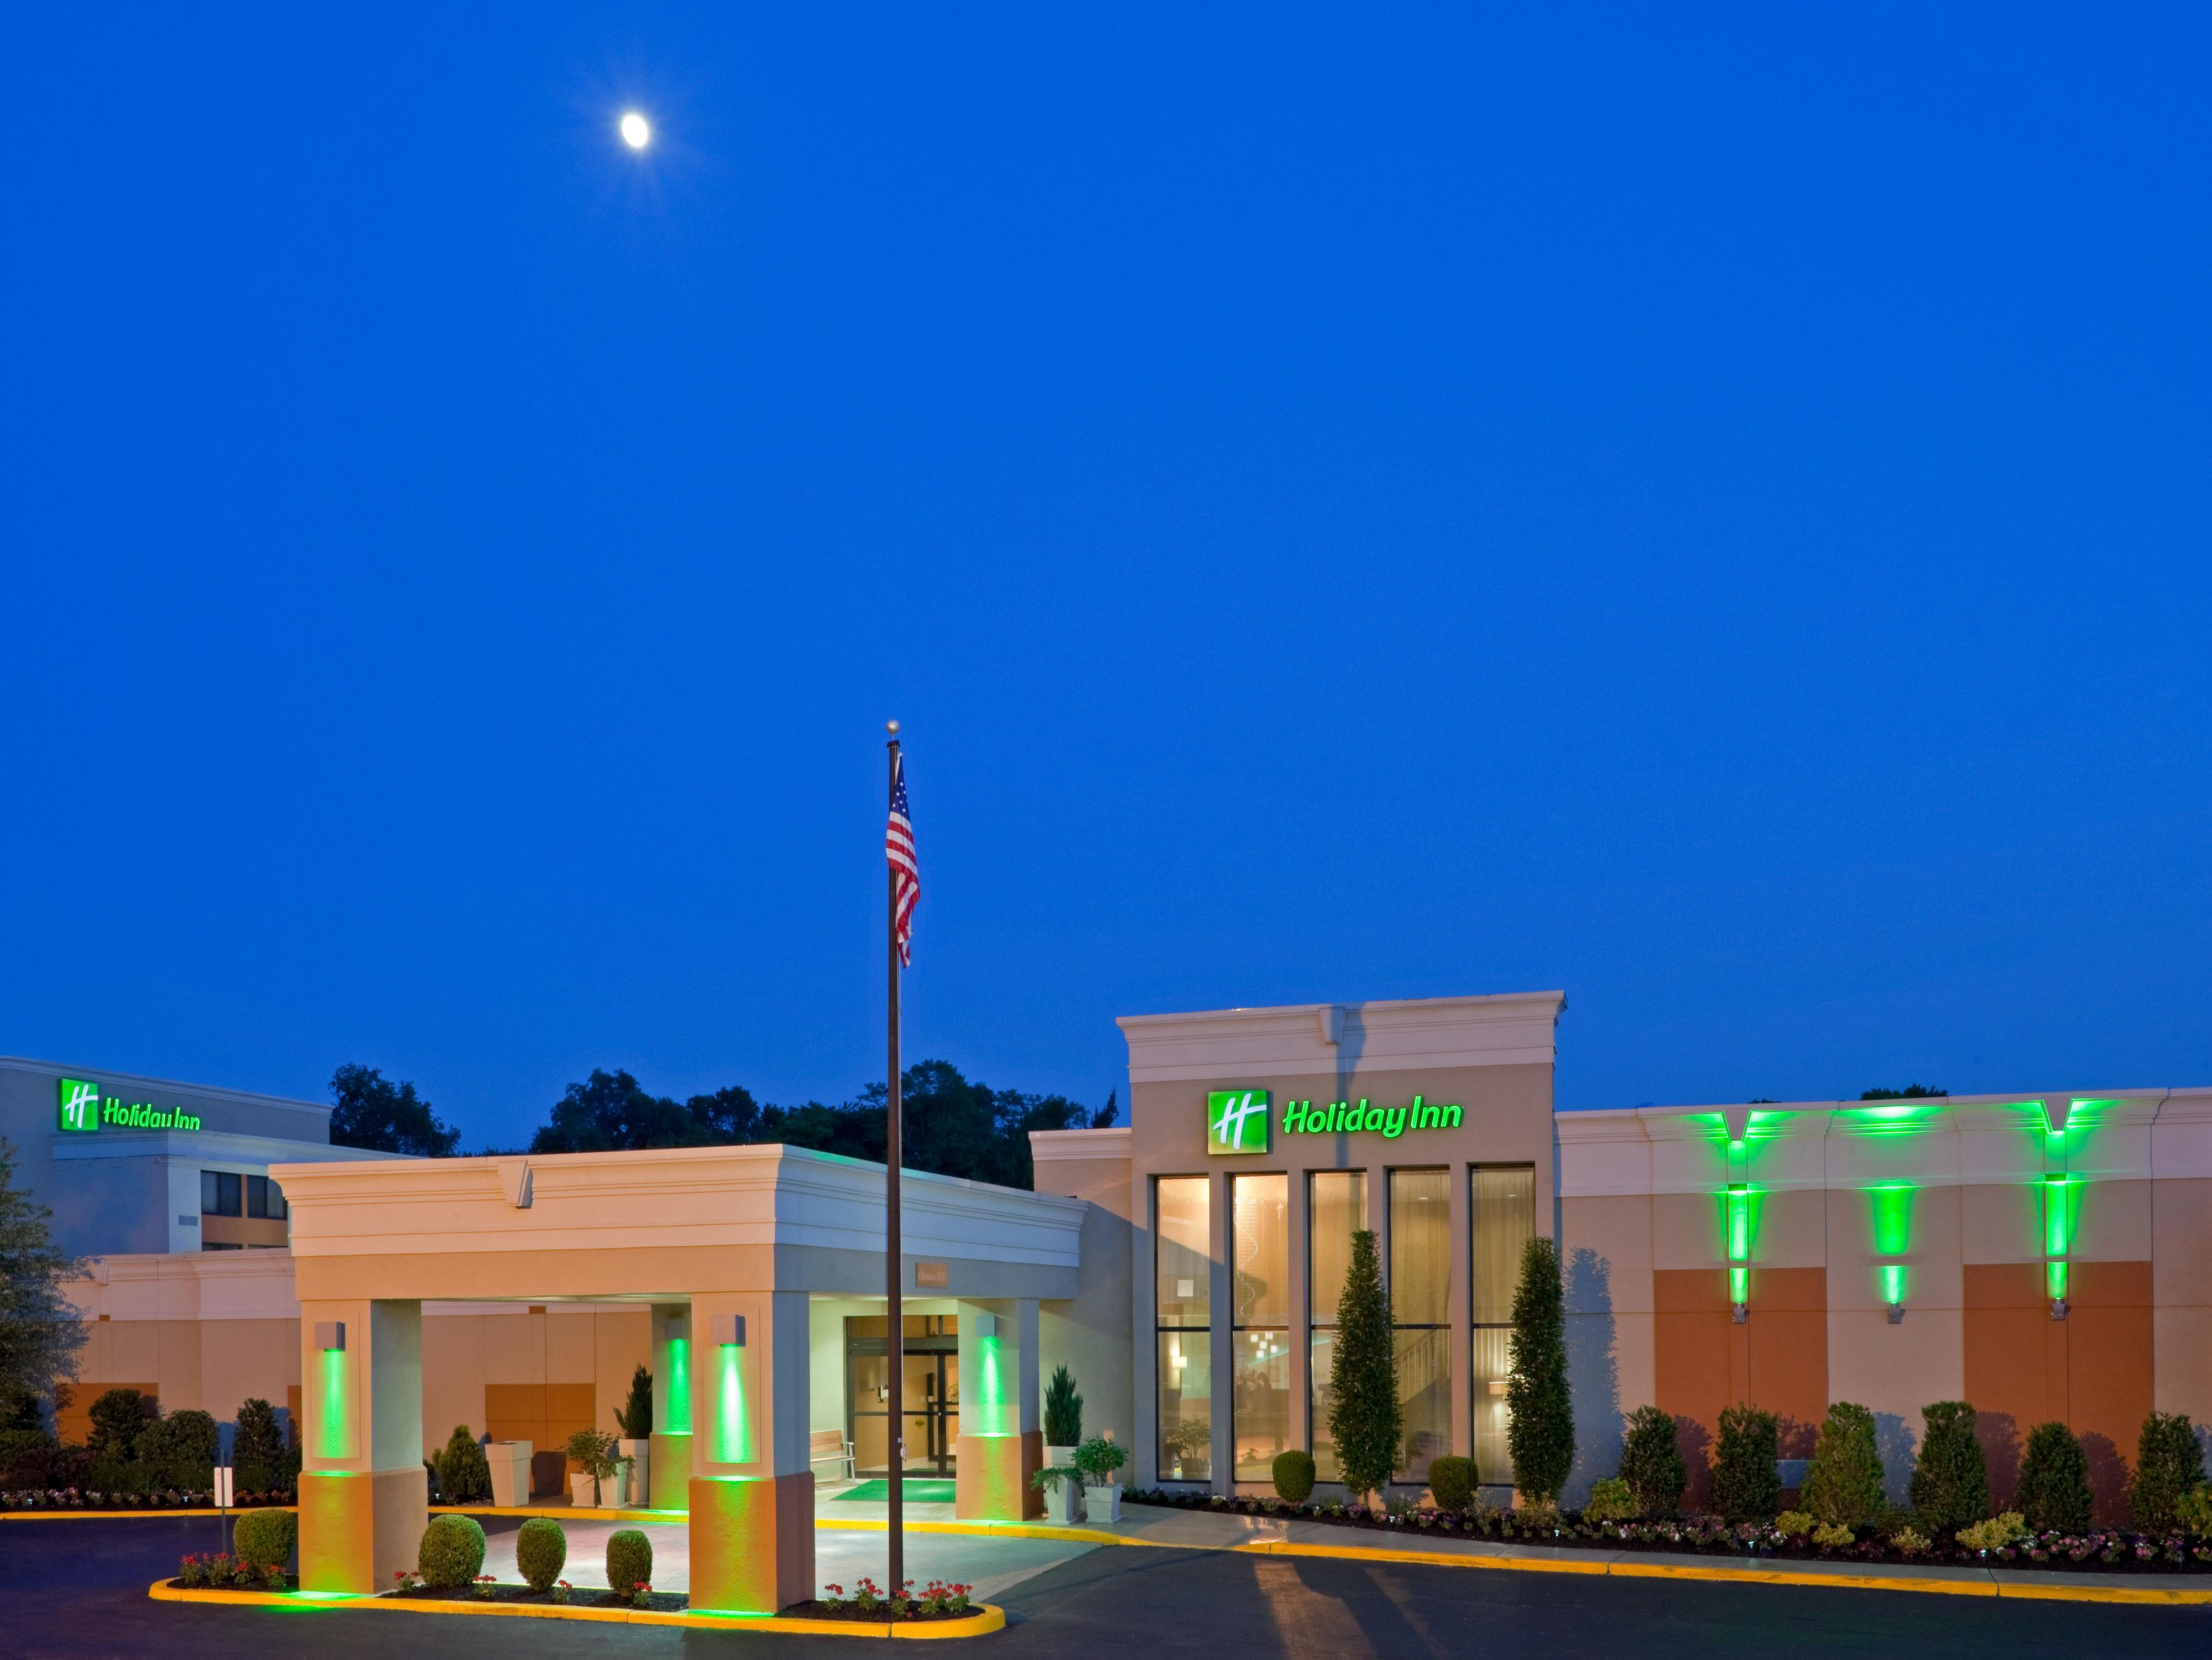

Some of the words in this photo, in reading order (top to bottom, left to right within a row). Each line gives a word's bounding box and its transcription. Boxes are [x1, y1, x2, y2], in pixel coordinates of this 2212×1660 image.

[174, 1107, 200, 1131] Inn
[1282, 1099, 1406, 1138] Holiday
[1410, 1095, 1462, 1129] Inn
